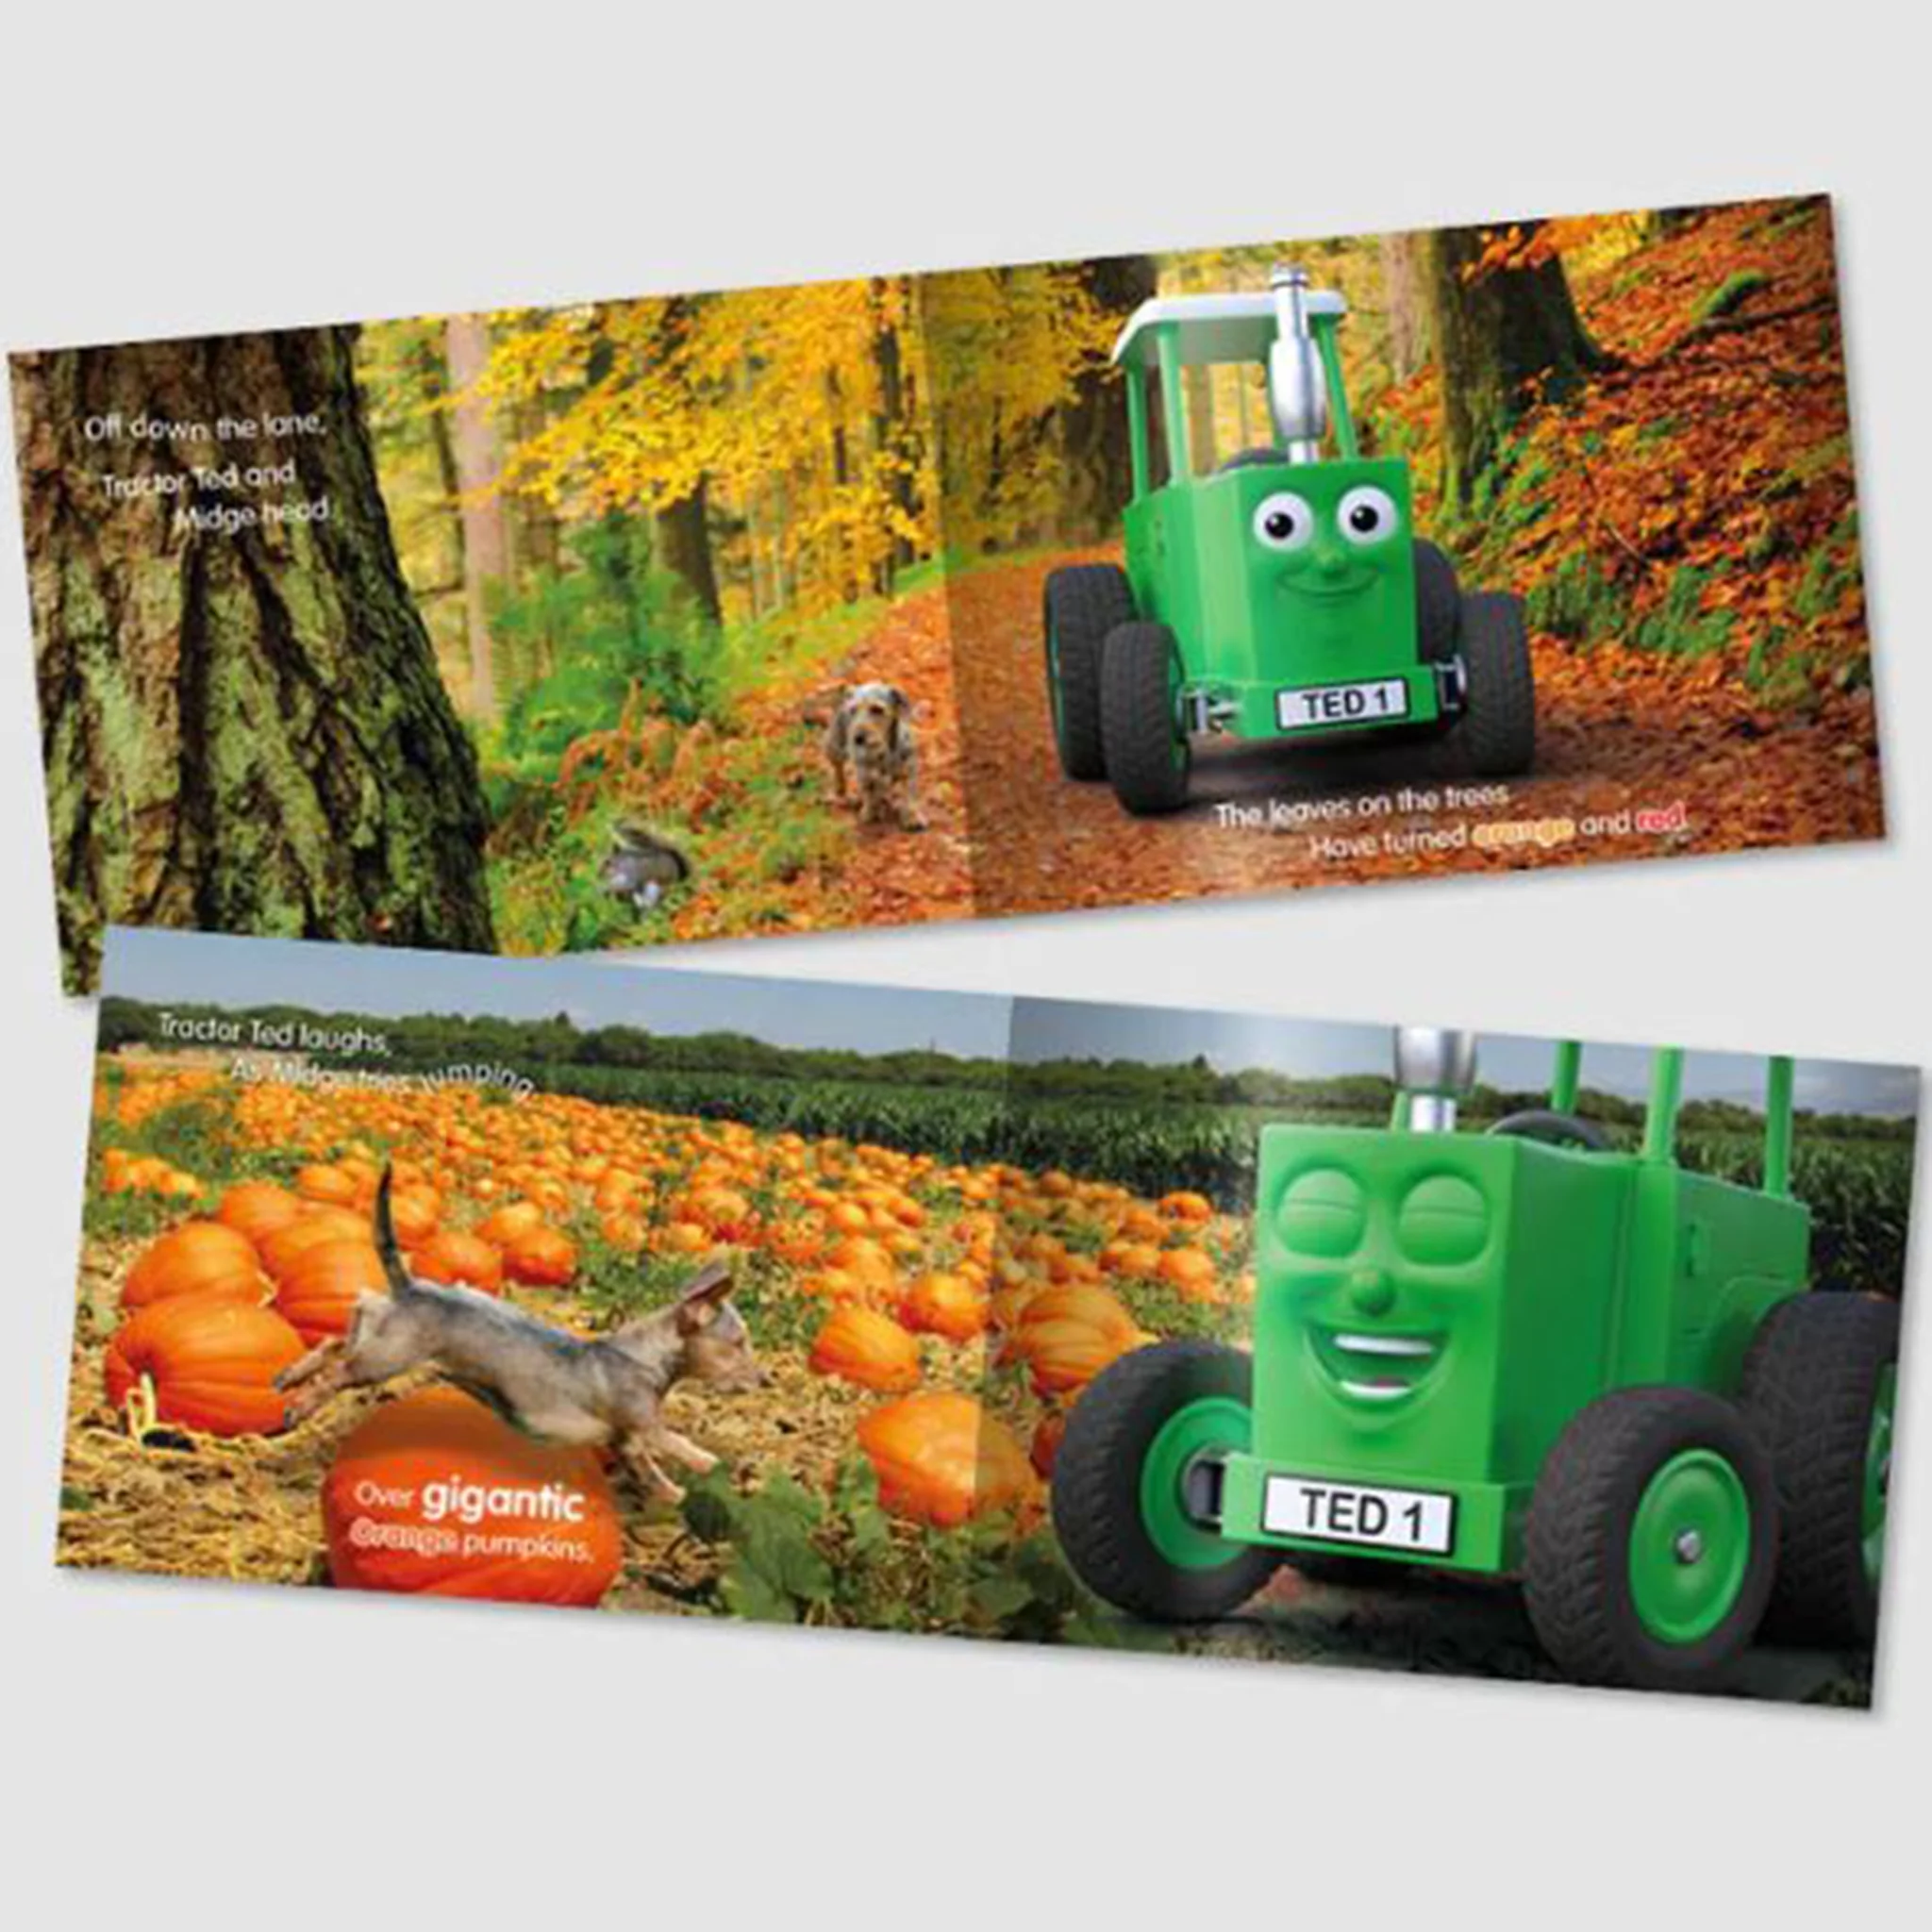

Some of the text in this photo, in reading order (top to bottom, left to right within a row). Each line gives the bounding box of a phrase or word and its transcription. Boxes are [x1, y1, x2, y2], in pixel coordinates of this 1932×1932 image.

[84, 414, 123, 441] Off
[129, 412, 209, 441] down
[216, 414, 258, 441] the
[103, 458, 295, 497] Tractor Ted and
[1301, 685, 1389, 720] TED 1
[1215, 784, 1509, 828] The leaves on the trees
[1308, 833, 1378, 859] Have
[1381, 823, 1467, 854] turned
[1580, 808, 1631, 836] and
[158, 1011, 240, 1041] Tractor
[250, 1020, 294, 1047] Ted
[353, 1474, 584, 1523] Over gigantic
[1300, 1488, 1423, 1542] TED 1
